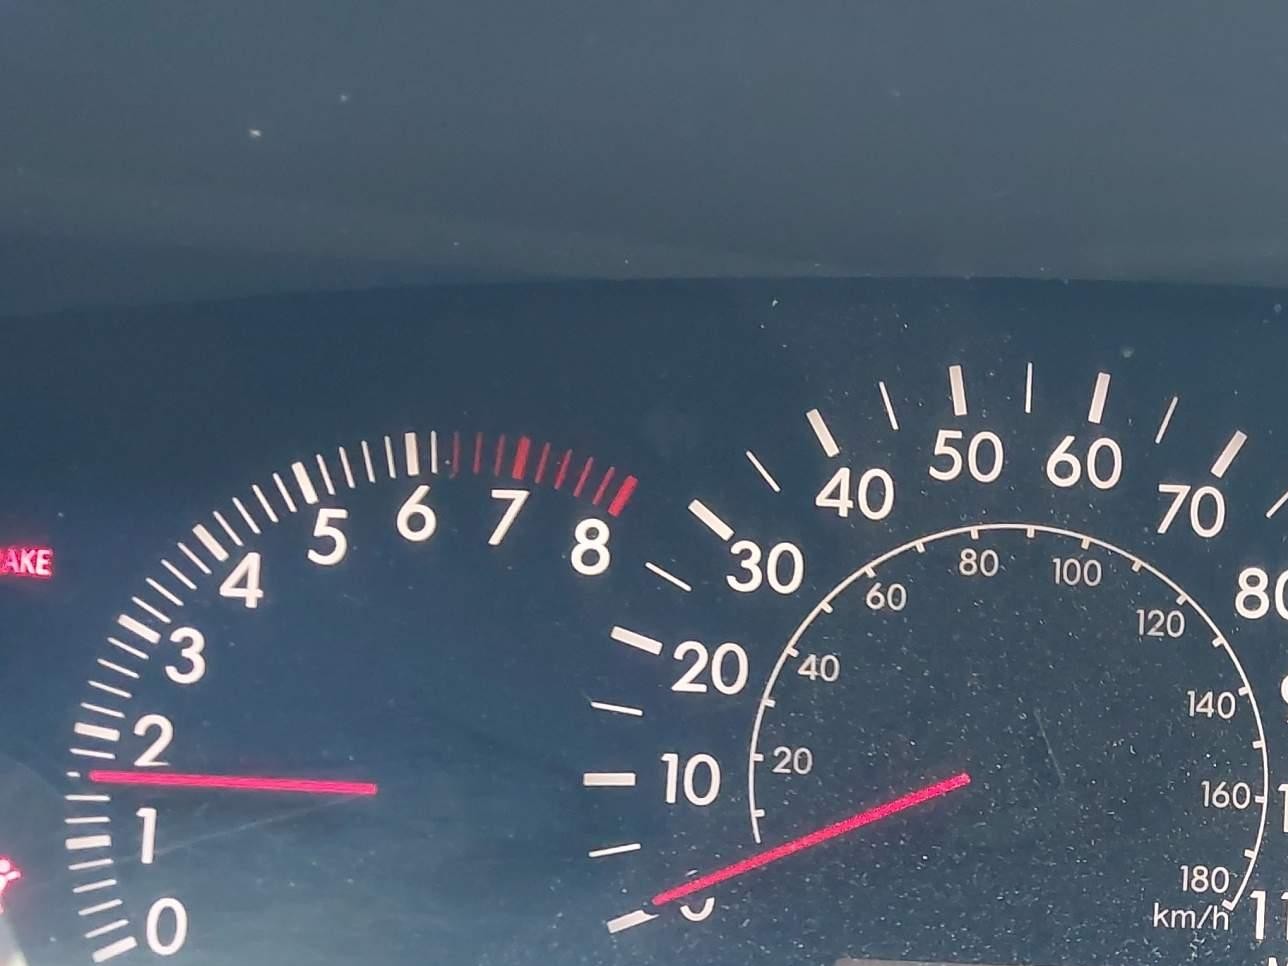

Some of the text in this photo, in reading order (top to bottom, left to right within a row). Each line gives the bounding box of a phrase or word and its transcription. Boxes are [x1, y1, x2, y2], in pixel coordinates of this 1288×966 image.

[929, 429, 1004, 483] 50
[1046, 435, 1122, 489] 60
[396, 485, 436, 542] 6
[488, 489, 530, 546] 7
[815, 467, 894, 520] 40
[1157, 483, 1225, 538] 70
[0, 548, 53, 576] AKE
[307, 508, 348, 565] 5
[570, 518, 611, 576] 8
[959, 548, 999, 577] 80
[219, 552, 264, 609] 4
[726, 540, 805, 594] 30
[1052, 558, 1102, 587] 100
[866, 582, 907, 611] 60
[1136, 609, 1185, 638] 120
[165, 626, 206, 684] 3
[671, 640, 749, 695] 20
[797, 654, 840, 682] 40
[1187, 690, 1236, 719] 140
[133, 714, 173, 767] 2
[772, 746, 813, 775] 20
[661, 753, 721, 806] 10
[1201, 780, 1251, 809] 160
[136, 807, 157, 865] 1
[1180, 865, 1230, 894] 180
[146, 897, 188, 956] 0
[1153, 902, 1230, 931] km/h
